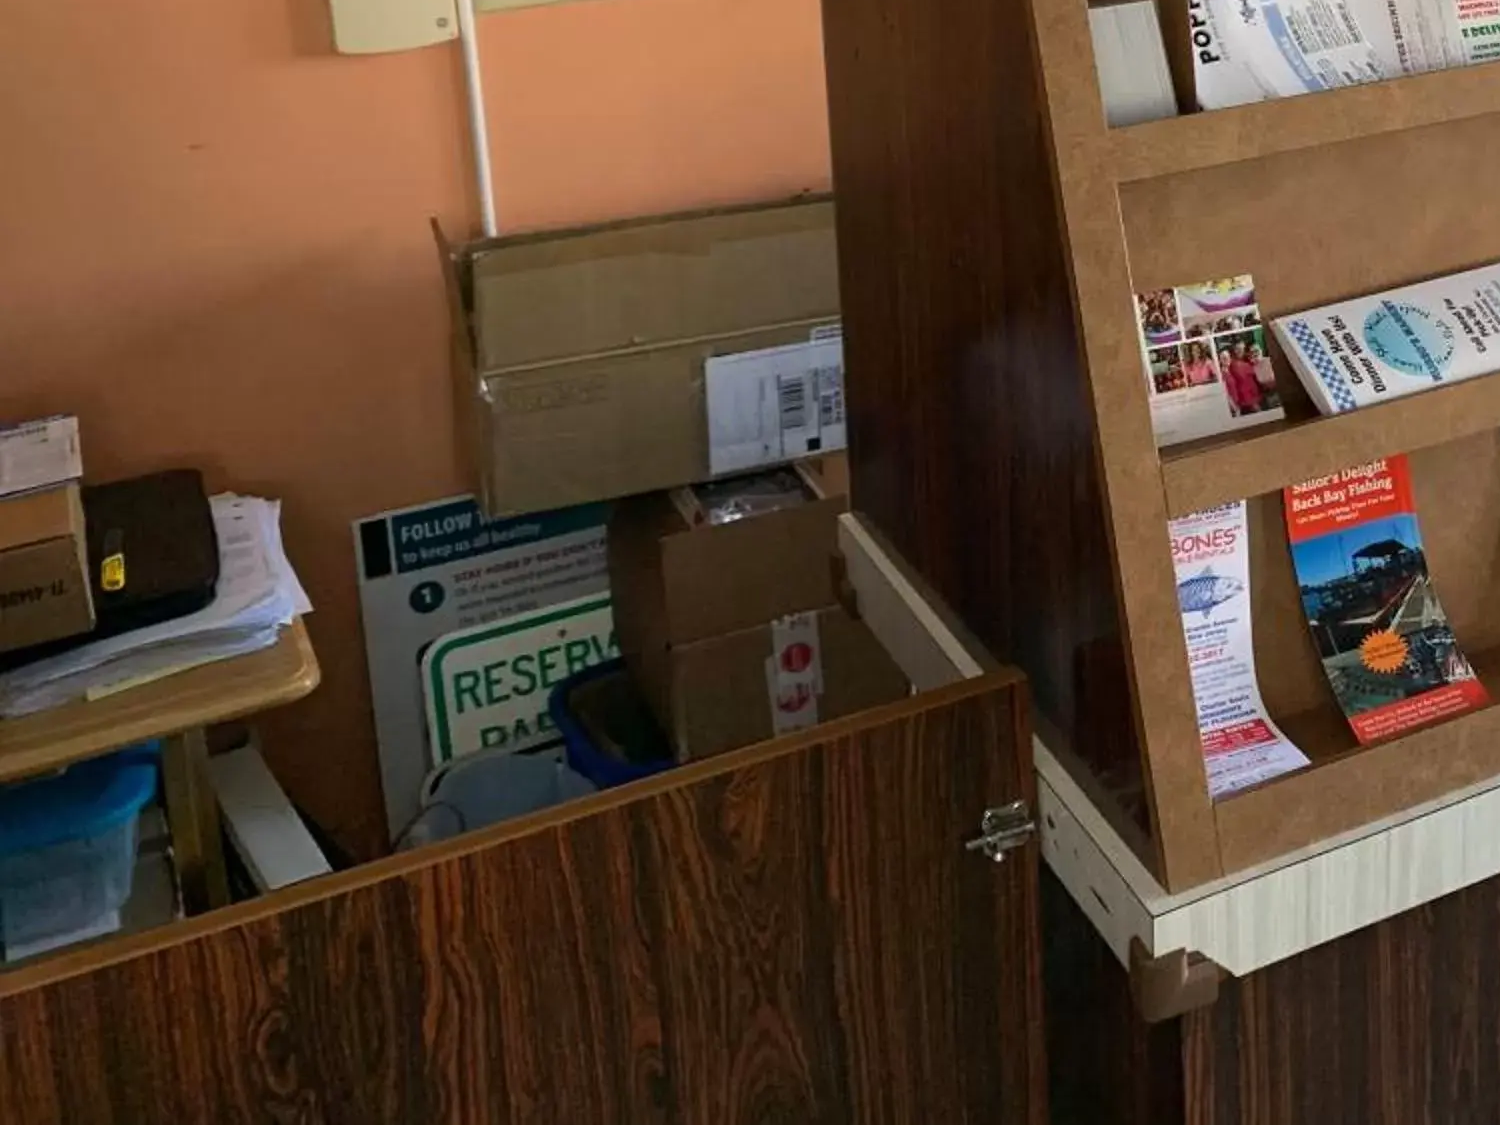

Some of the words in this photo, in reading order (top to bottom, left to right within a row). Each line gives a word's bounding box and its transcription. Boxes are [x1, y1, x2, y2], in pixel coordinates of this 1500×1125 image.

[1321, 328, 1342, 354] Have
[1345, 333, 1365, 360] With
[1339, 354, 1363, 385] Come
[1359, 359, 1387, 394] Dinner
[1292, 473, 1339, 495] Sailor's
[1340, 459, 1389, 482] Delight
[1292, 494, 1322, 512] Back
[1323, 488, 1347, 504] Bay
[1347, 476, 1394, 496] Fishing
[399, 511, 474, 544] FOLLOW
[402, 551, 417, 565] to
[420, 542, 453, 564] keep
[454, 540, 471, 553] us
[491, 522, 543, 545] healthy
[420, 586, 432, 604] 1
[453, 630, 622, 714] RESERV
